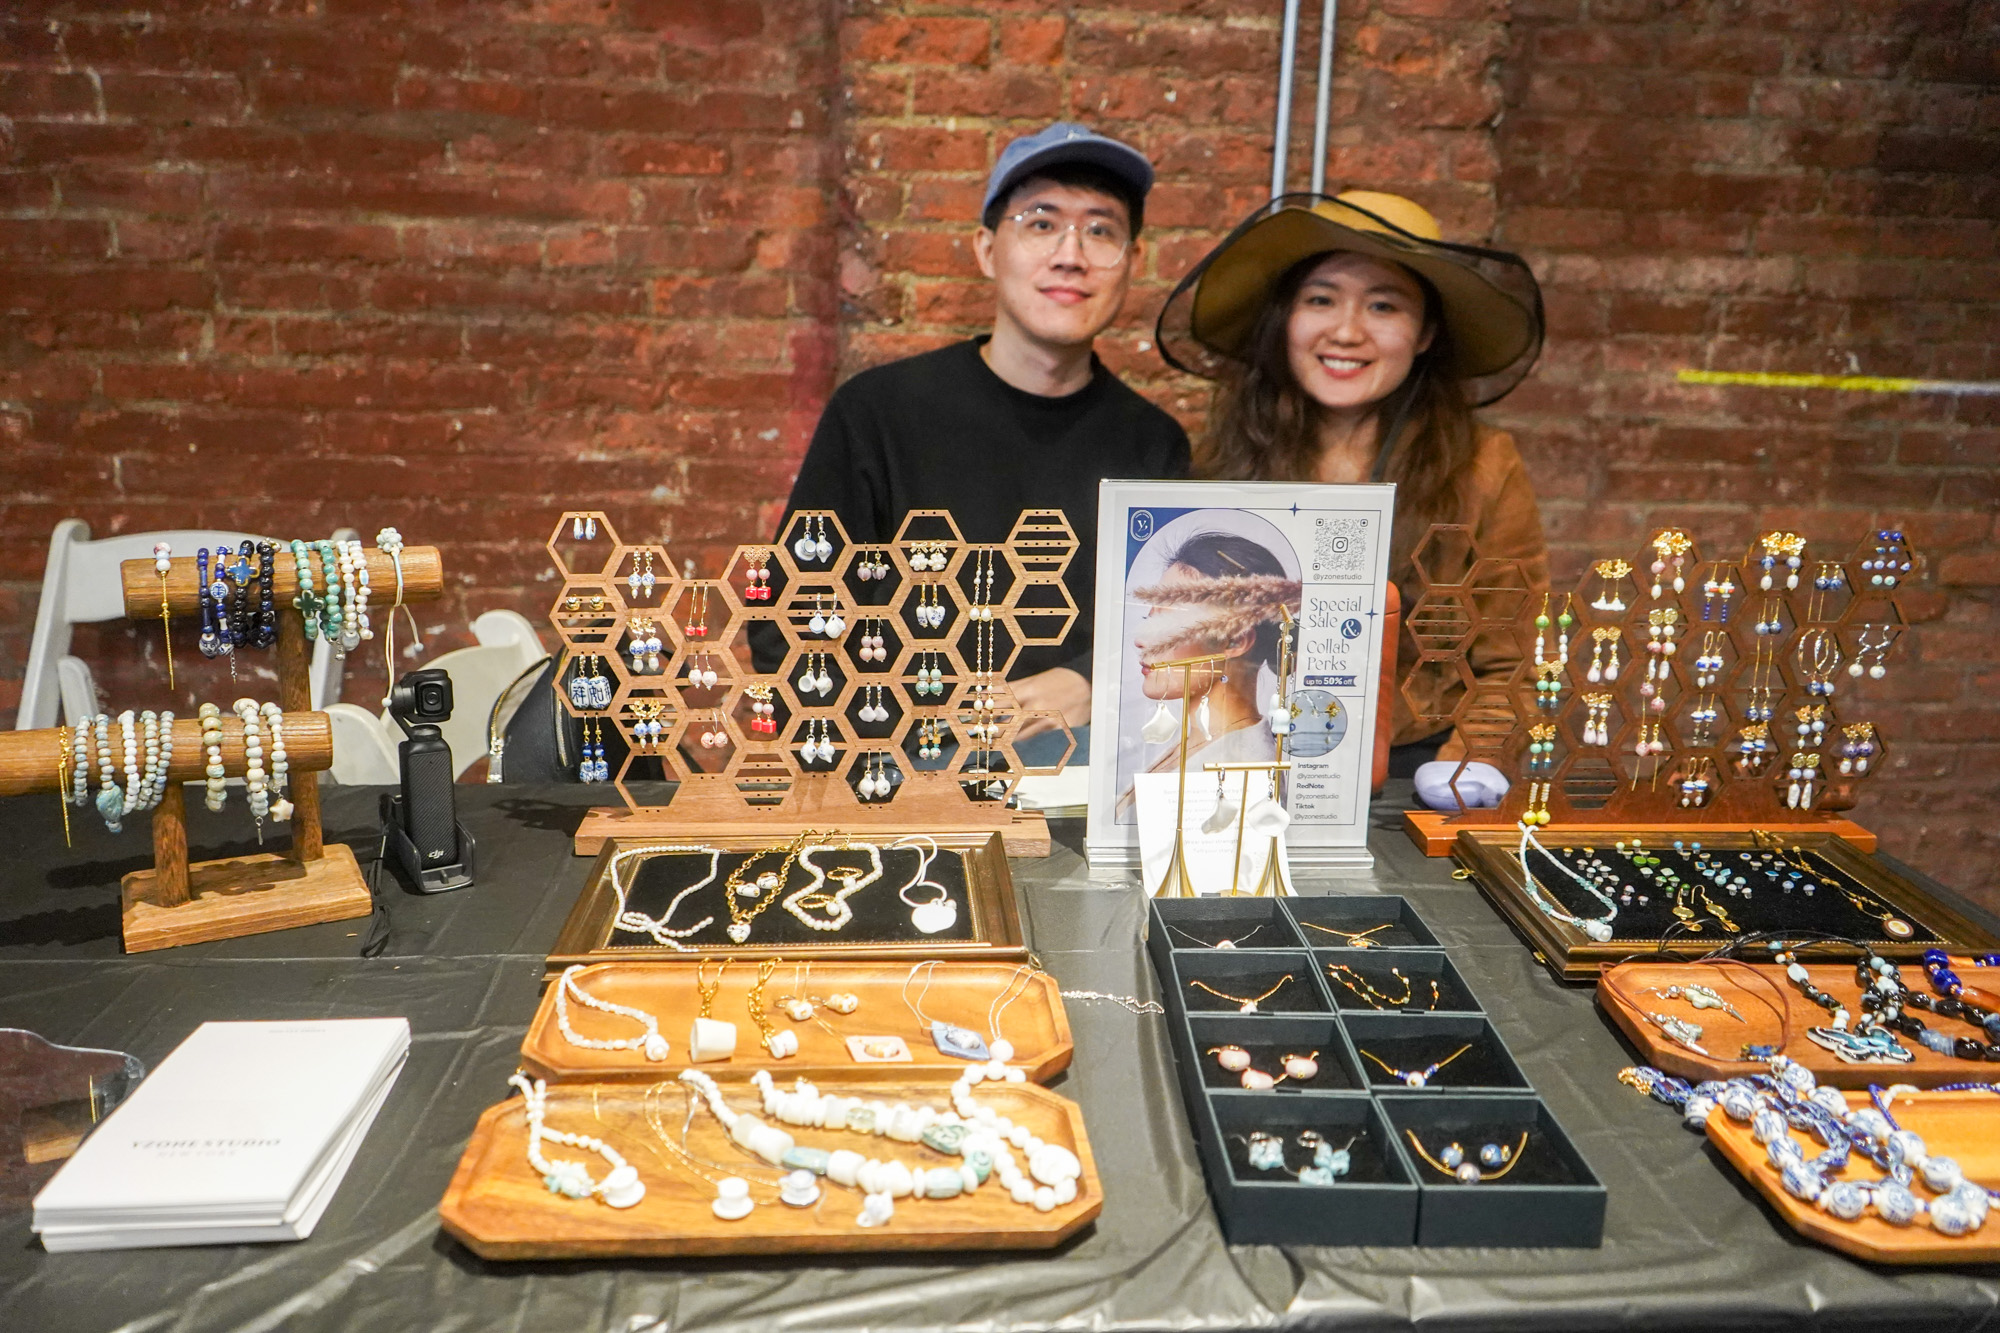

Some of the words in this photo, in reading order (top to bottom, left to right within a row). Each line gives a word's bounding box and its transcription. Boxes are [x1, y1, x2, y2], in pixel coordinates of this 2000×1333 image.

[1313, 573, 1362, 581] @yzonestudio
[1310, 595, 1362, 616] Special
[1308, 612, 1338, 628] Sale
[1342, 619, 1360, 637] &
[1306, 638, 1350, 654] Collab
[1307, 655, 1347, 671] Perks
[1323, 677, 1343, 685] 50%
[1297, 762, 1329, 770] Instagram
